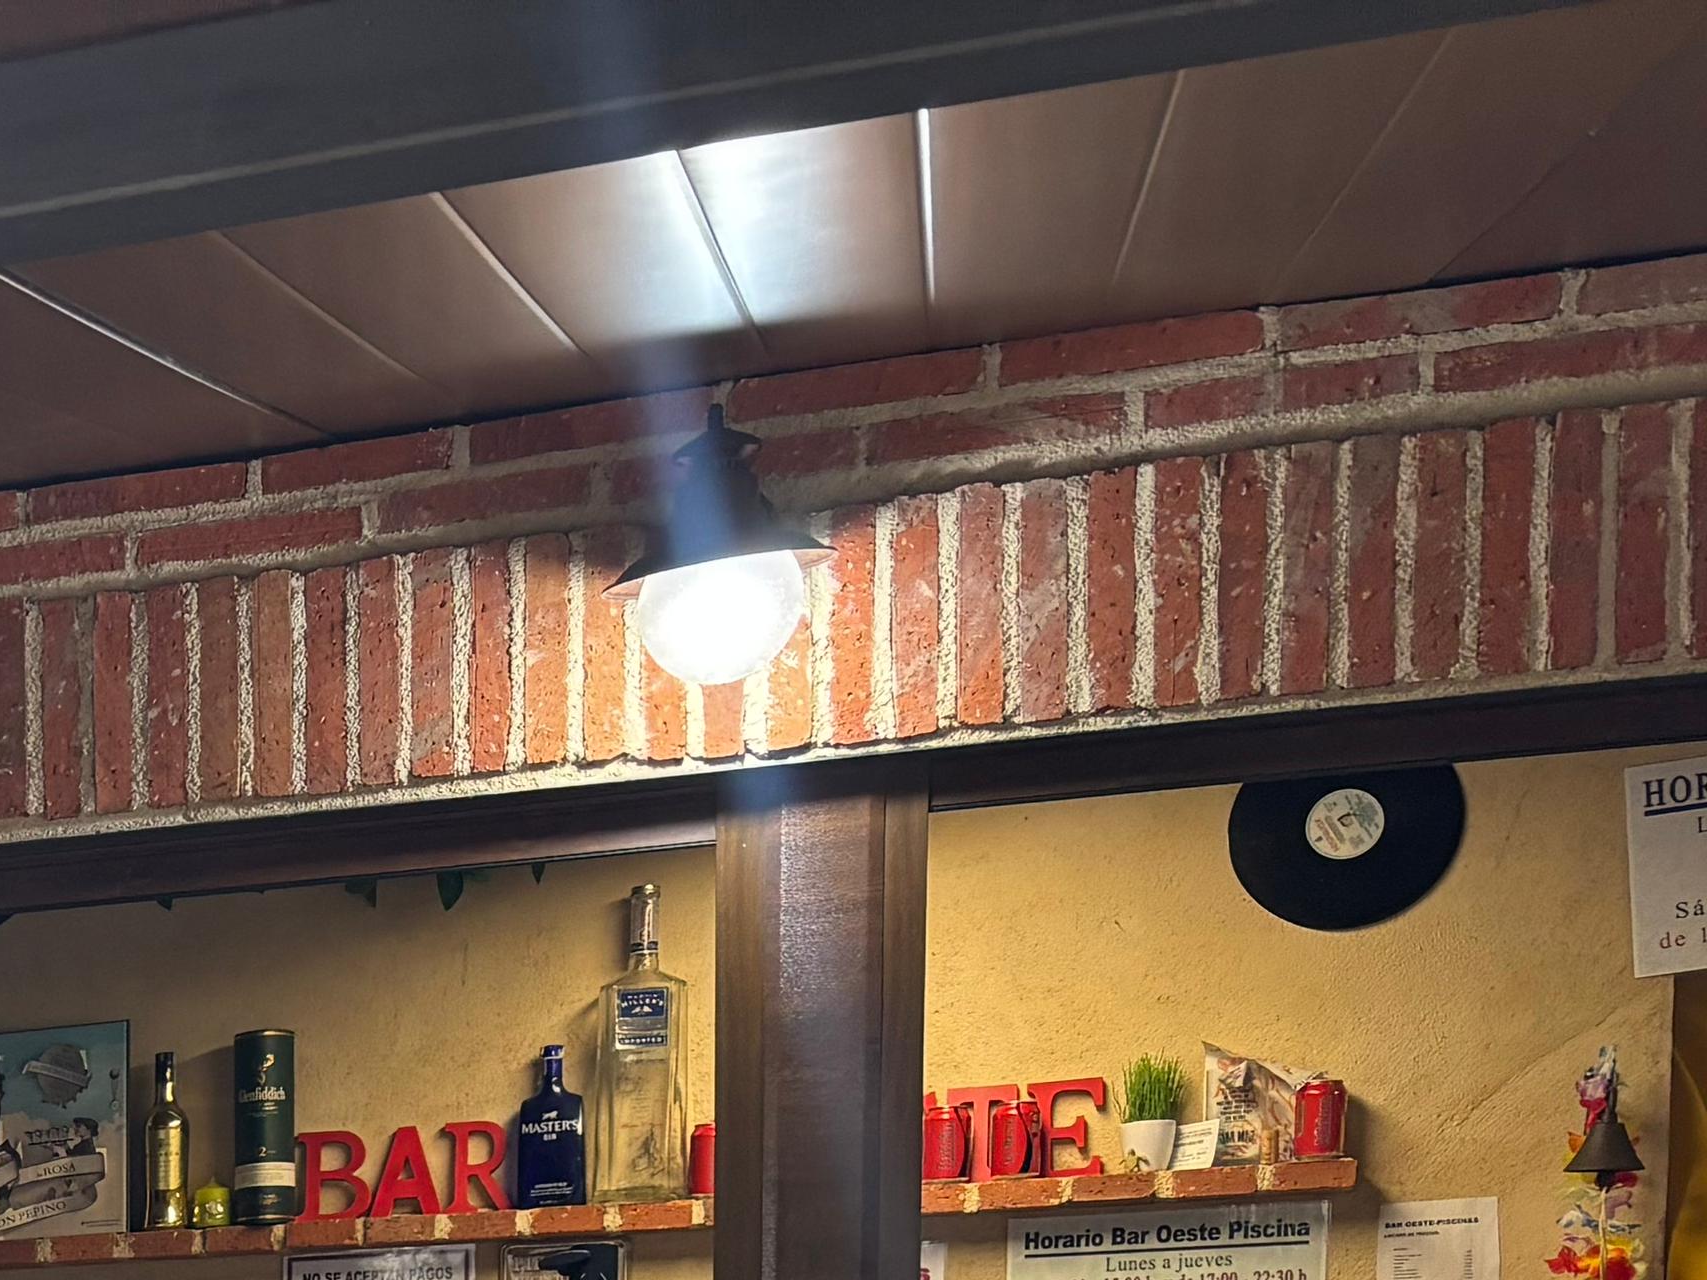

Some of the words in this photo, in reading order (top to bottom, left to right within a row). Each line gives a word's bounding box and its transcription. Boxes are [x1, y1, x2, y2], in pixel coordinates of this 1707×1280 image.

[1660, 932, 1686, 949] de
[522, 1119, 579, 1134] MASTER'S
[43, 1162, 76, 1177] ROSA
[294, 1121, 513, 1224] BAR
[19, 1200, 67, 1222] PEPINO
[1025, 1230, 1103, 1250] Horario
[1112, 1227, 1148, 1246] Bar
[1156, 1223, 1220, 1242] Oeste
[1229, 1219, 1310, 1239] Piscina
[1106, 1257, 1156, 1272] Lunes
[1163, 1259, 1171, 1269] a
[1175, 1254, 1233, 1272] jueves
